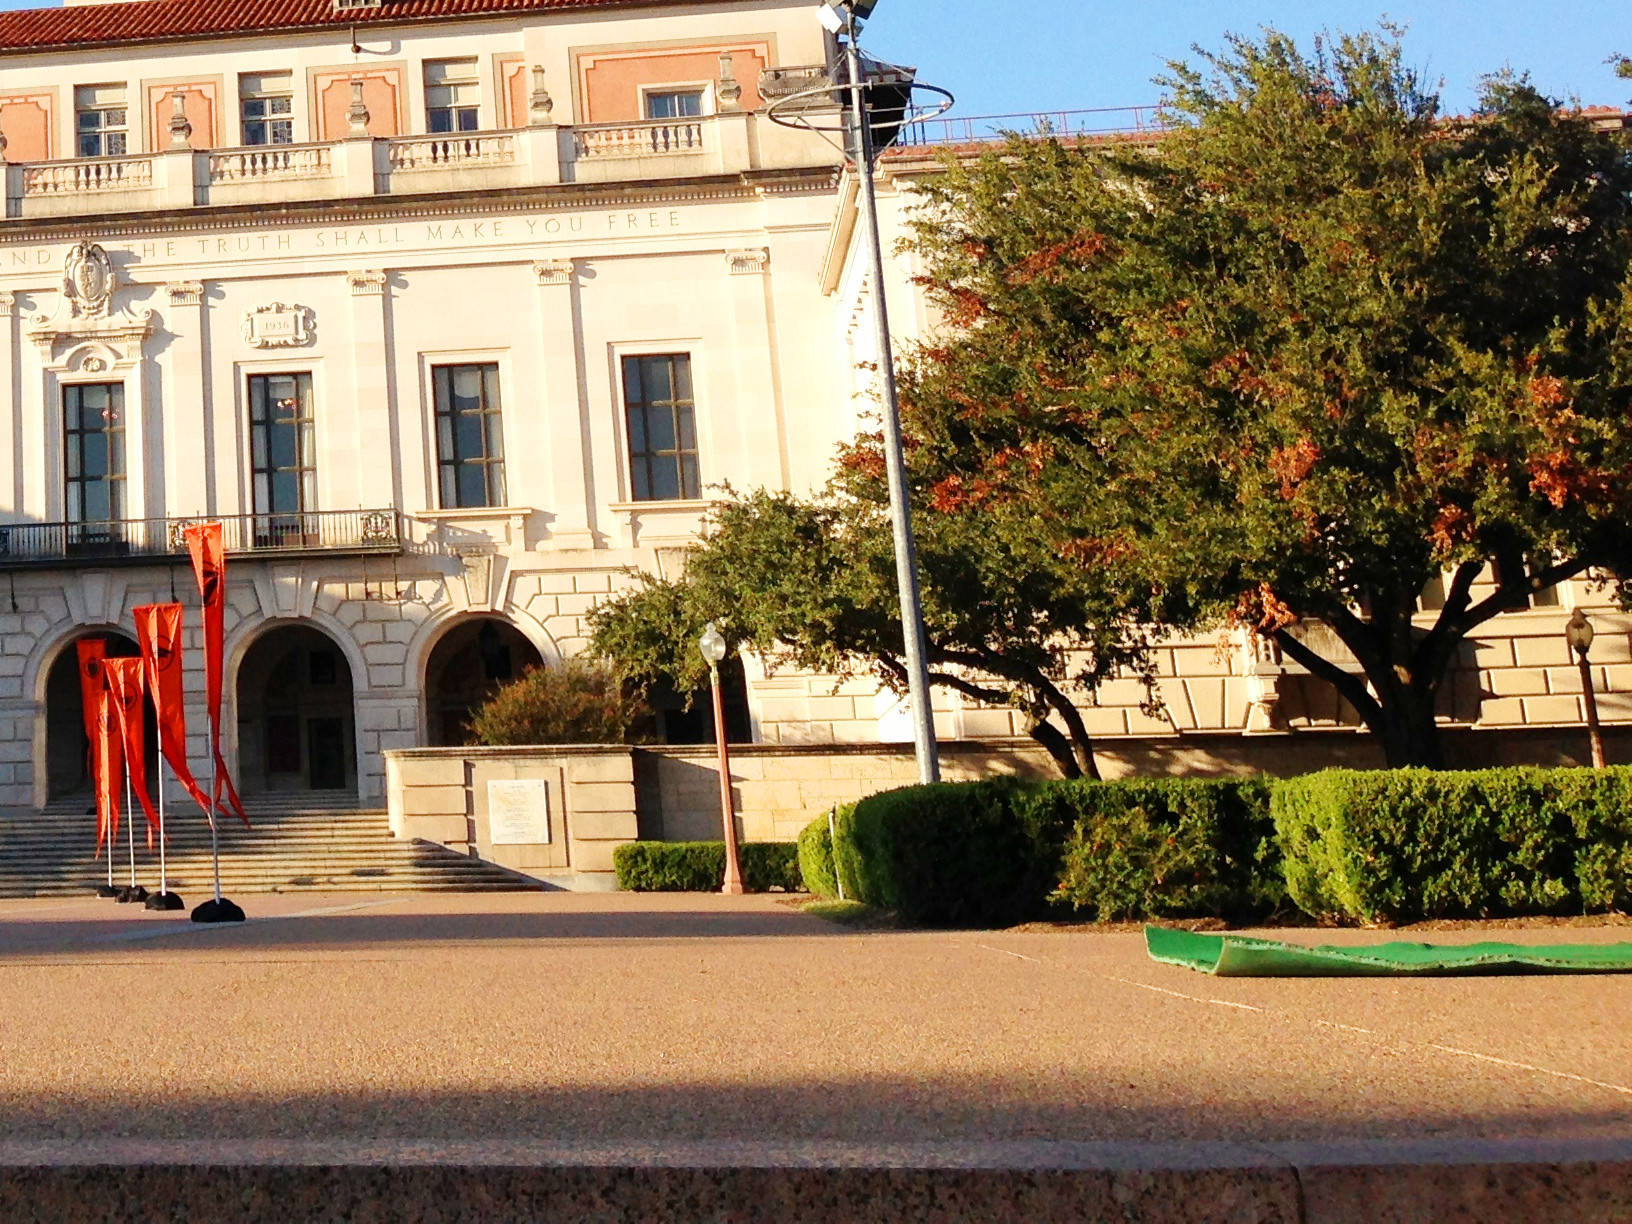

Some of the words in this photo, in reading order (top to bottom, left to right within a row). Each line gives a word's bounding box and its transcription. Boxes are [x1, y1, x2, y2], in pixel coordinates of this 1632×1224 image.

[123, 241, 177, 259] THE
[197, 234, 291, 254] TRUTH
[316, 227, 406, 248] SHALL
[426, 221, 505, 241] MAKE
[525, 215, 583, 234] YOU
[608, 211, 681, 231] FREE
